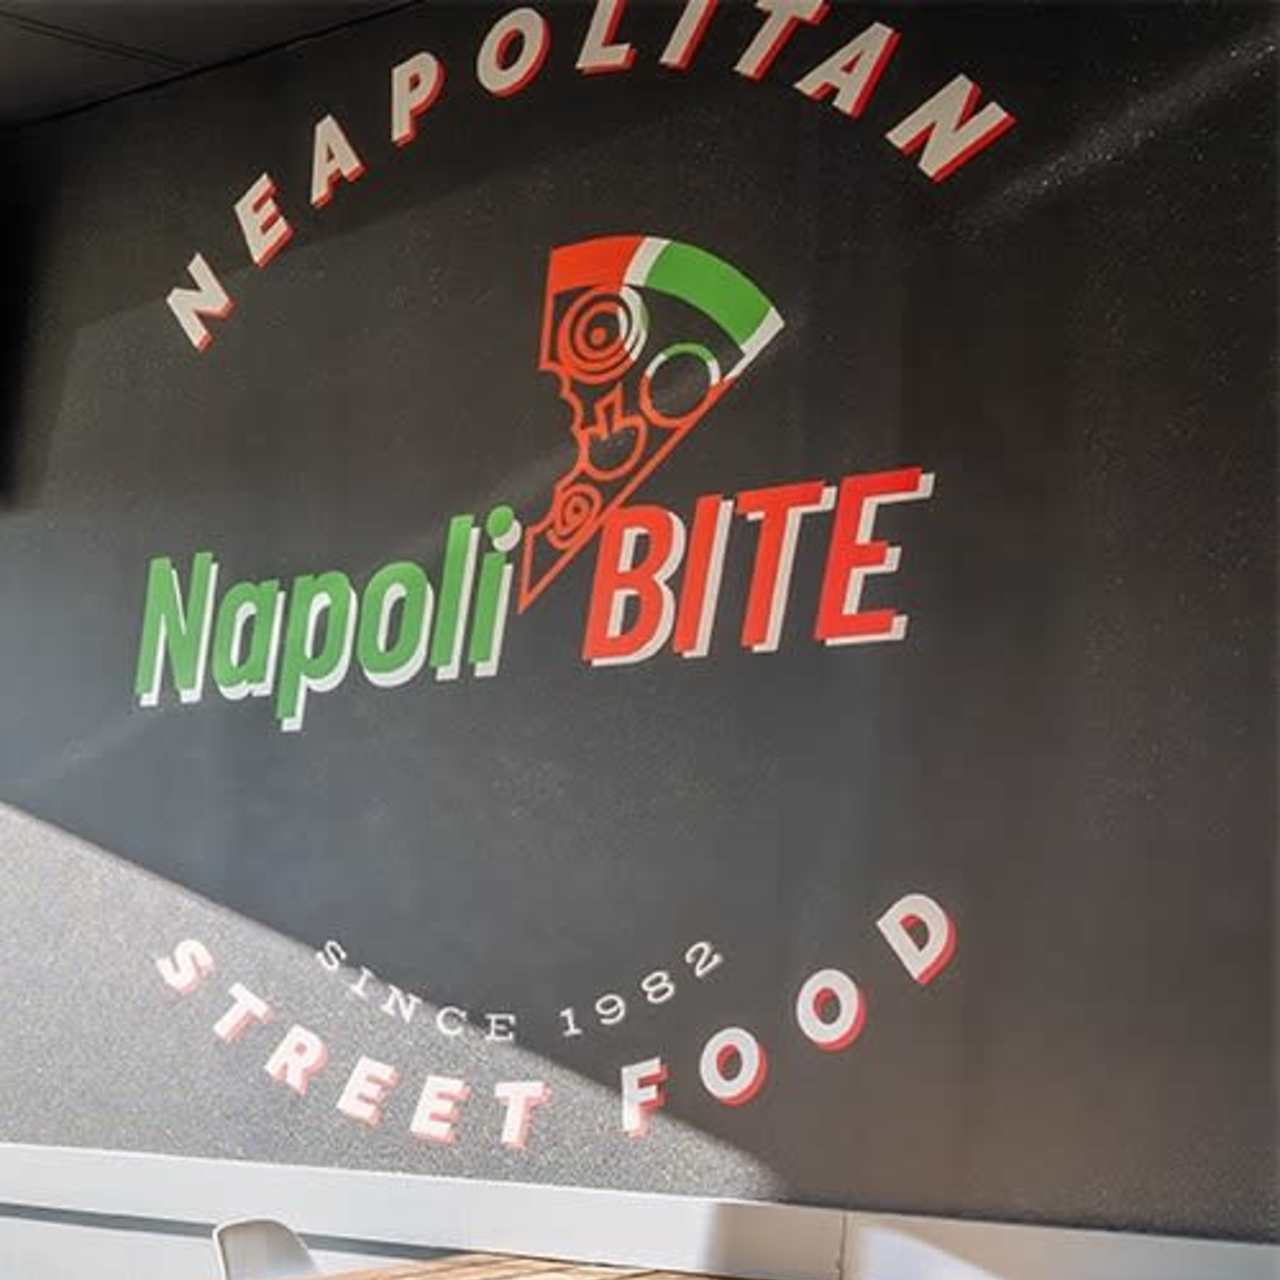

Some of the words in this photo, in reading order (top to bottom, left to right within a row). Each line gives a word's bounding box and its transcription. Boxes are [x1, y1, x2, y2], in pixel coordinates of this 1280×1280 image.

[167, 0, 1015, 349] NEAPOLITAN
[133, 505, 521, 731] Napoli
[582, 469, 935, 666] BITE
[156, 938, 552, 1149] STREET
[620, 893, 957, 1137] FOOD
[316, 940, 517, 1041] SINCE
[561, 941, 724, 1036] 1982
